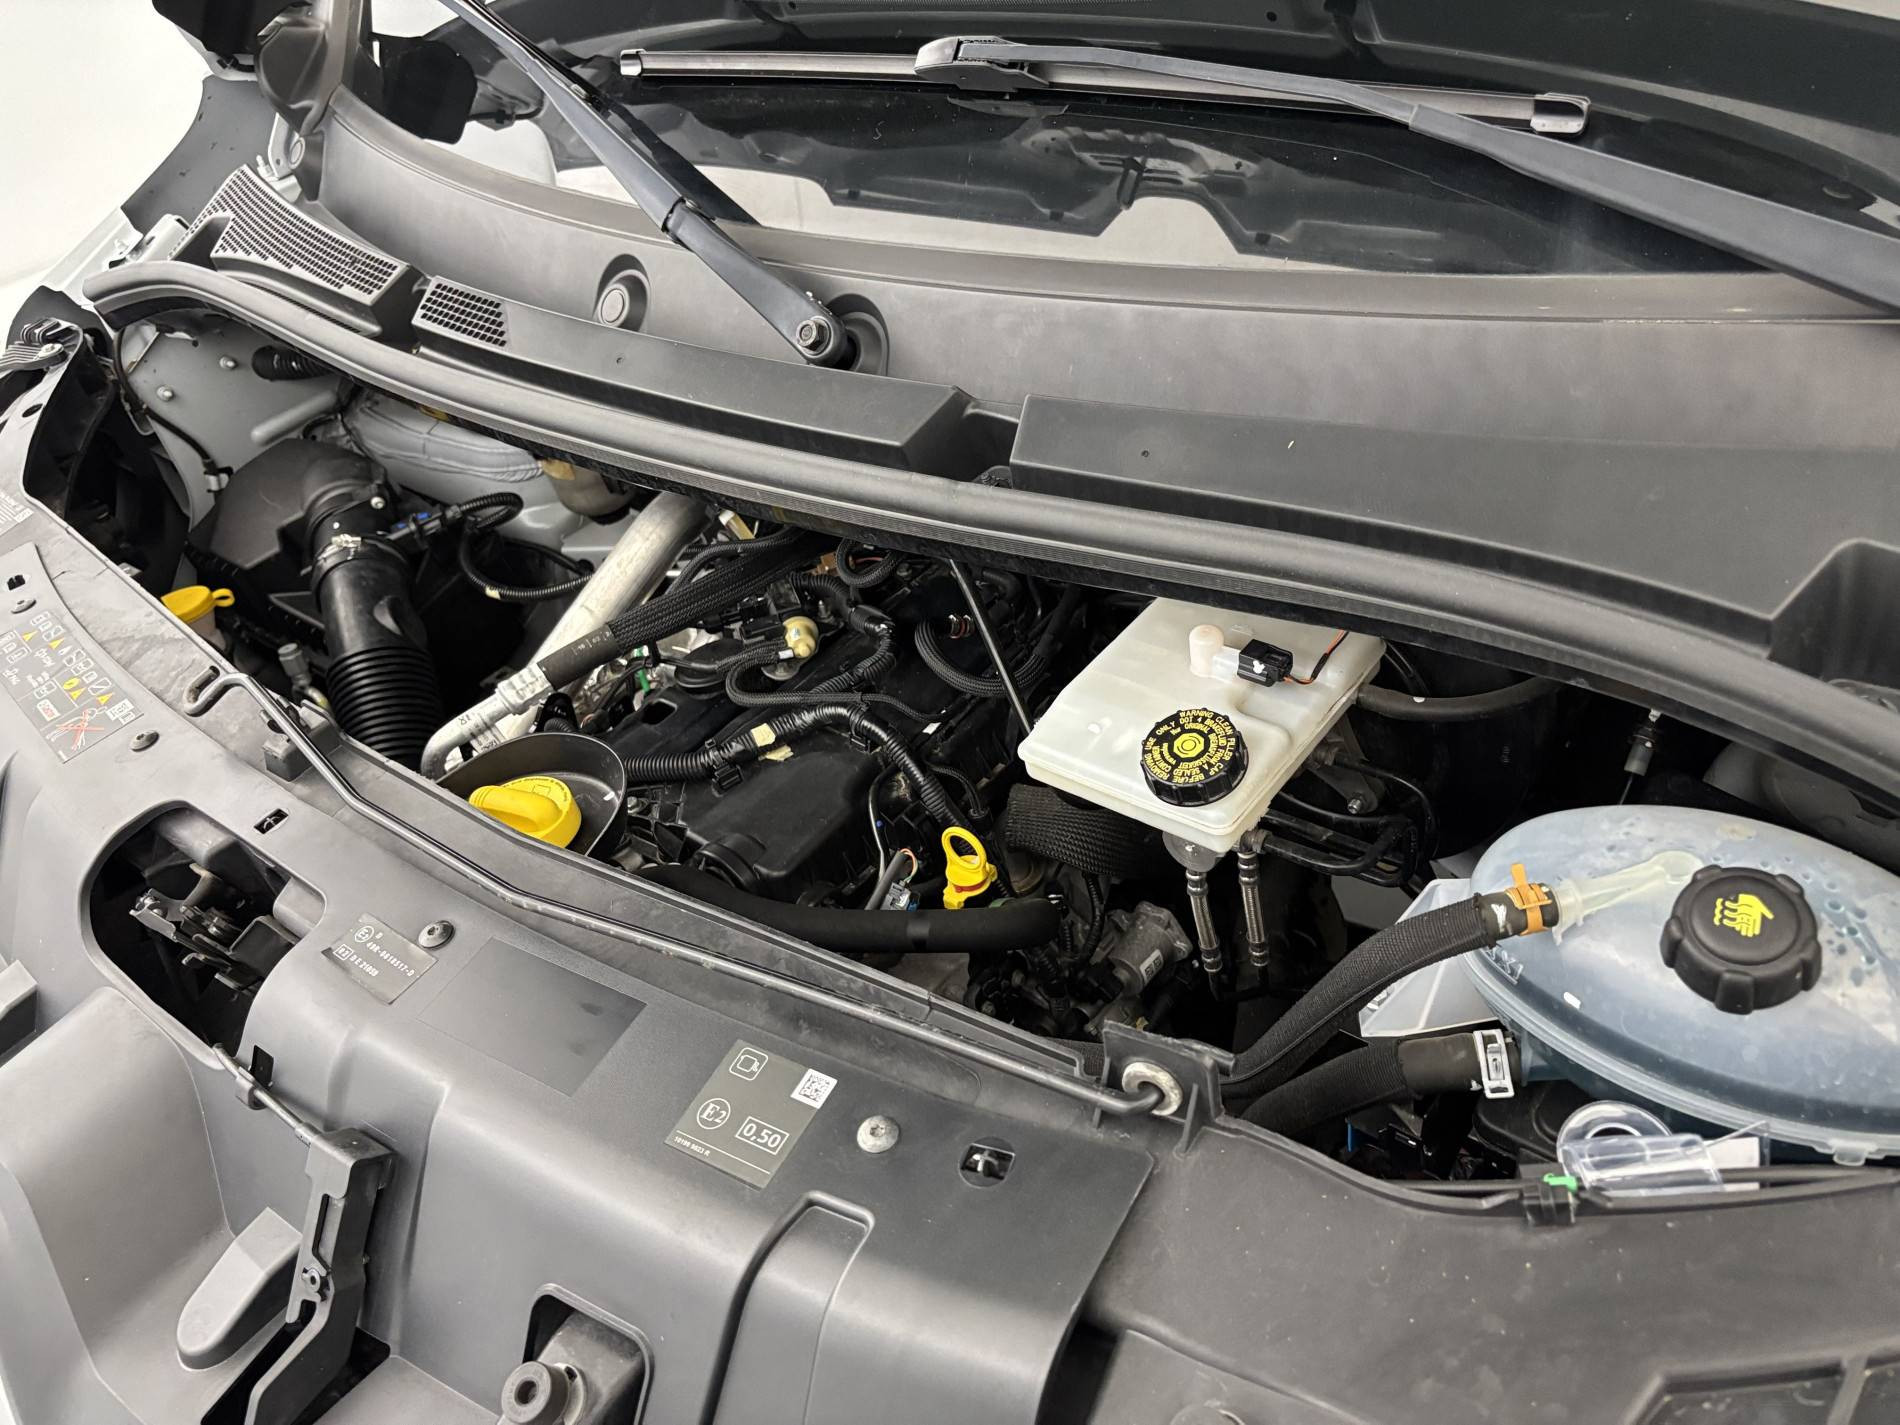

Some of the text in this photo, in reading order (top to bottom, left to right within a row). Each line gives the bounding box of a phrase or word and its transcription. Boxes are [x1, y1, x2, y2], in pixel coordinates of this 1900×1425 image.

[1180, 710, 1214, 719] WARNING
[1180, 716, 1193, 724] DOT
[1156, 720, 1176, 735] ONLY
[1215, 716, 1233, 735] CLEAN
[1144, 737, 1156, 750] USE
[1223, 737, 1235, 761] FILLER
[1211, 748, 1225, 765] FROM
[1144, 753, 1170, 780] REMOVING
[1173, 767, 1201, 776] SEALED
[1210, 762, 1224, 776] CAP
[700, 1102, 727, 1123] E2
[743, 1123, 782, 1148] 0,50
